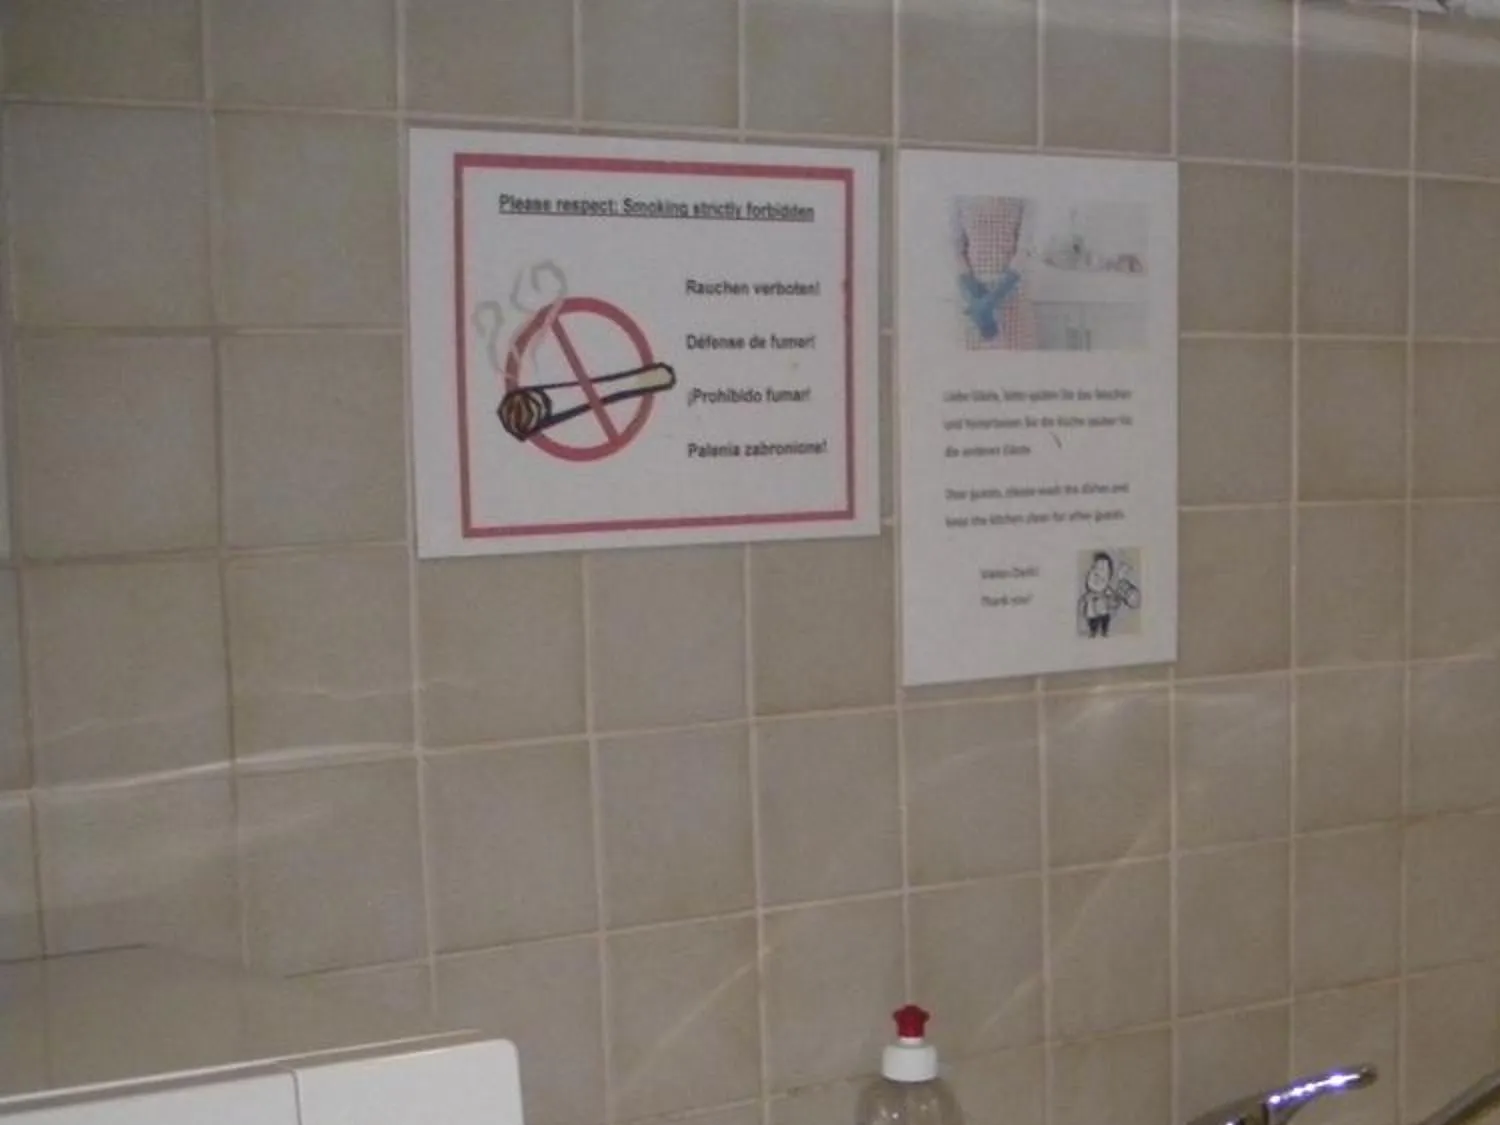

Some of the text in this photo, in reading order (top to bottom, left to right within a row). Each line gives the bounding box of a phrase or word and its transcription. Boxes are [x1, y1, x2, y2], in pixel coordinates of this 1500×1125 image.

[498, 193, 553, 213] Please
[622, 197, 689, 218] Smoking
[692, 200, 742, 219] strictly
[745, 201, 815, 221] forbidden
[685, 279, 821, 297] Rauchen verboten!
[749, 333, 767, 350] de
[769, 331, 816, 349] fumer!
[765, 385, 812, 403] fumar!
[687, 442, 740, 458] Palenia
